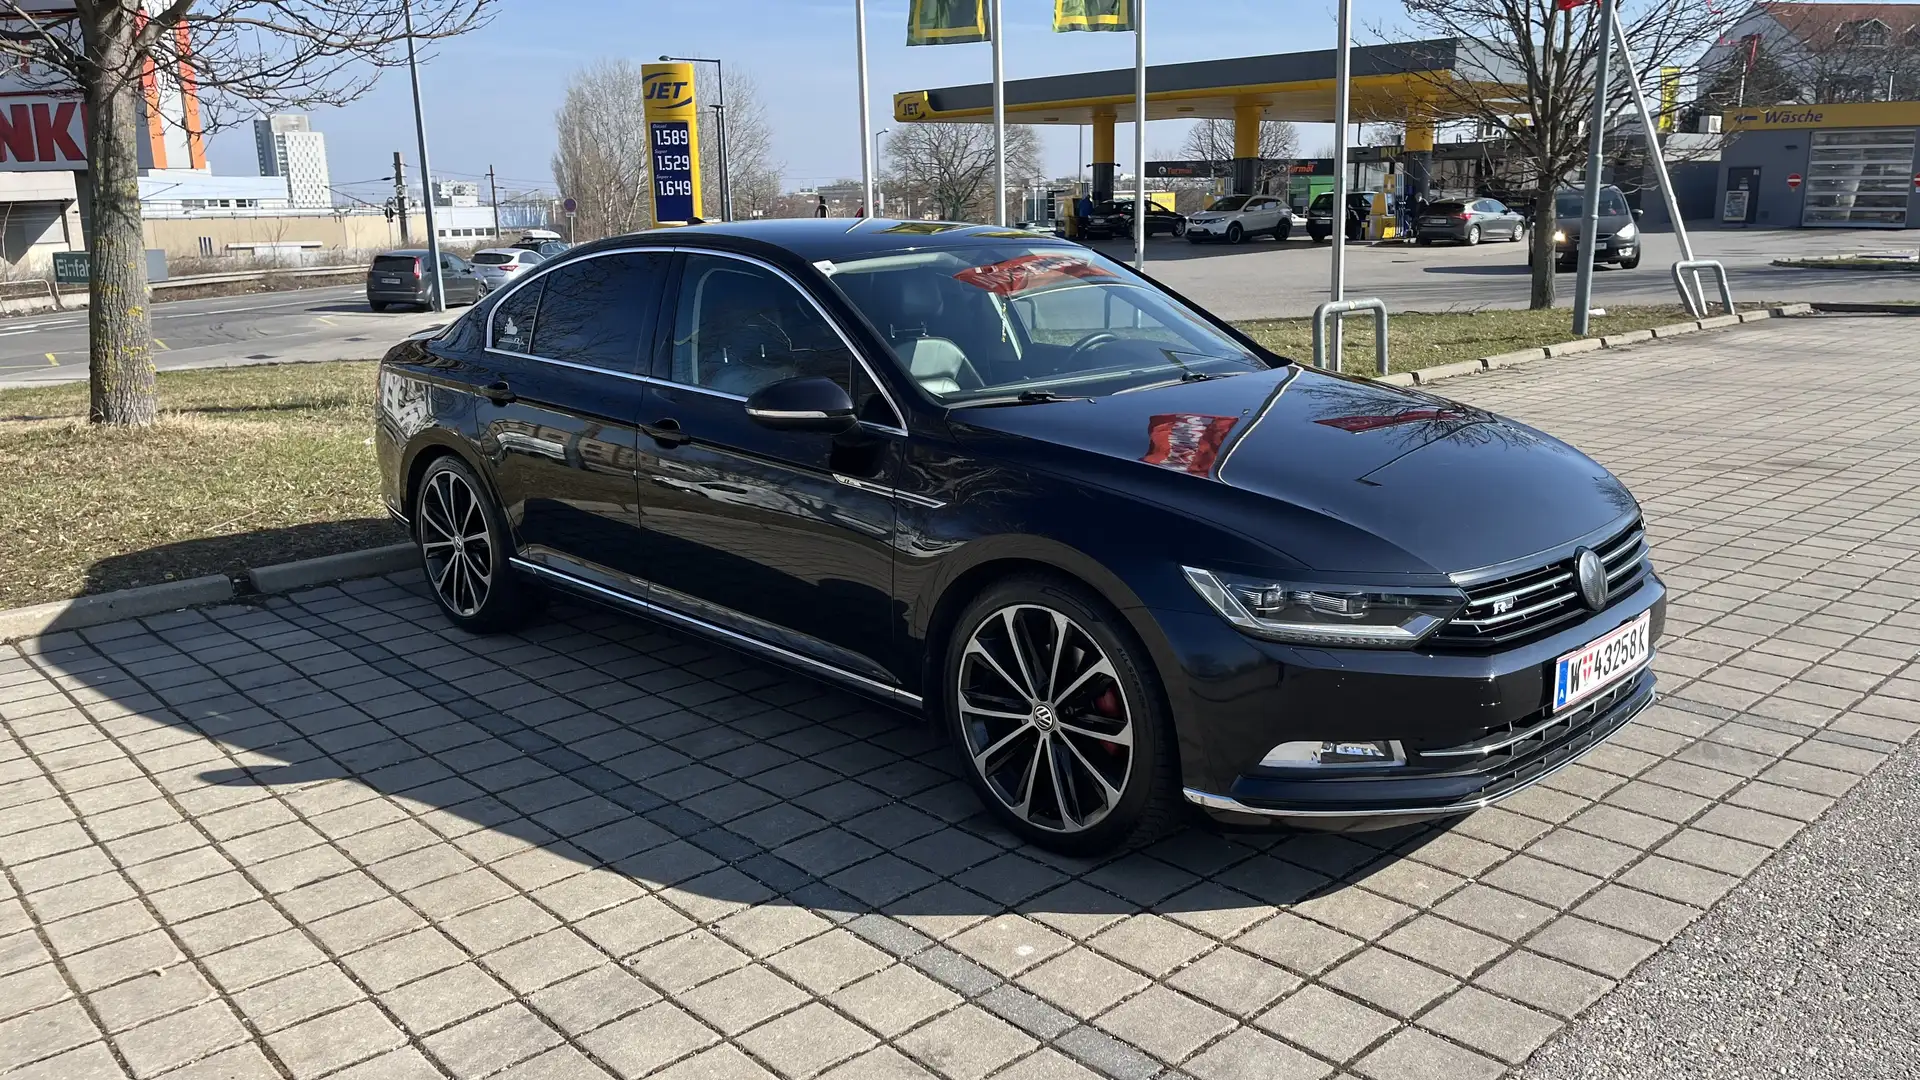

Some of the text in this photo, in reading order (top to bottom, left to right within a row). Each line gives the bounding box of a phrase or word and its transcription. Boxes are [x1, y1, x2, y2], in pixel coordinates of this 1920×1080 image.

[644, 82, 688, 99] JET
[903, 102, 919, 115] JET
[1765, 109, 1823, 123] Wäsche
[0, 102, 88, 162] NK
[655, 129, 688, 146] 1.589
[657, 155, 690, 171] 1.529
[659, 180, 691, 196] 1.649
[1571, 658, 1582, 694] W
